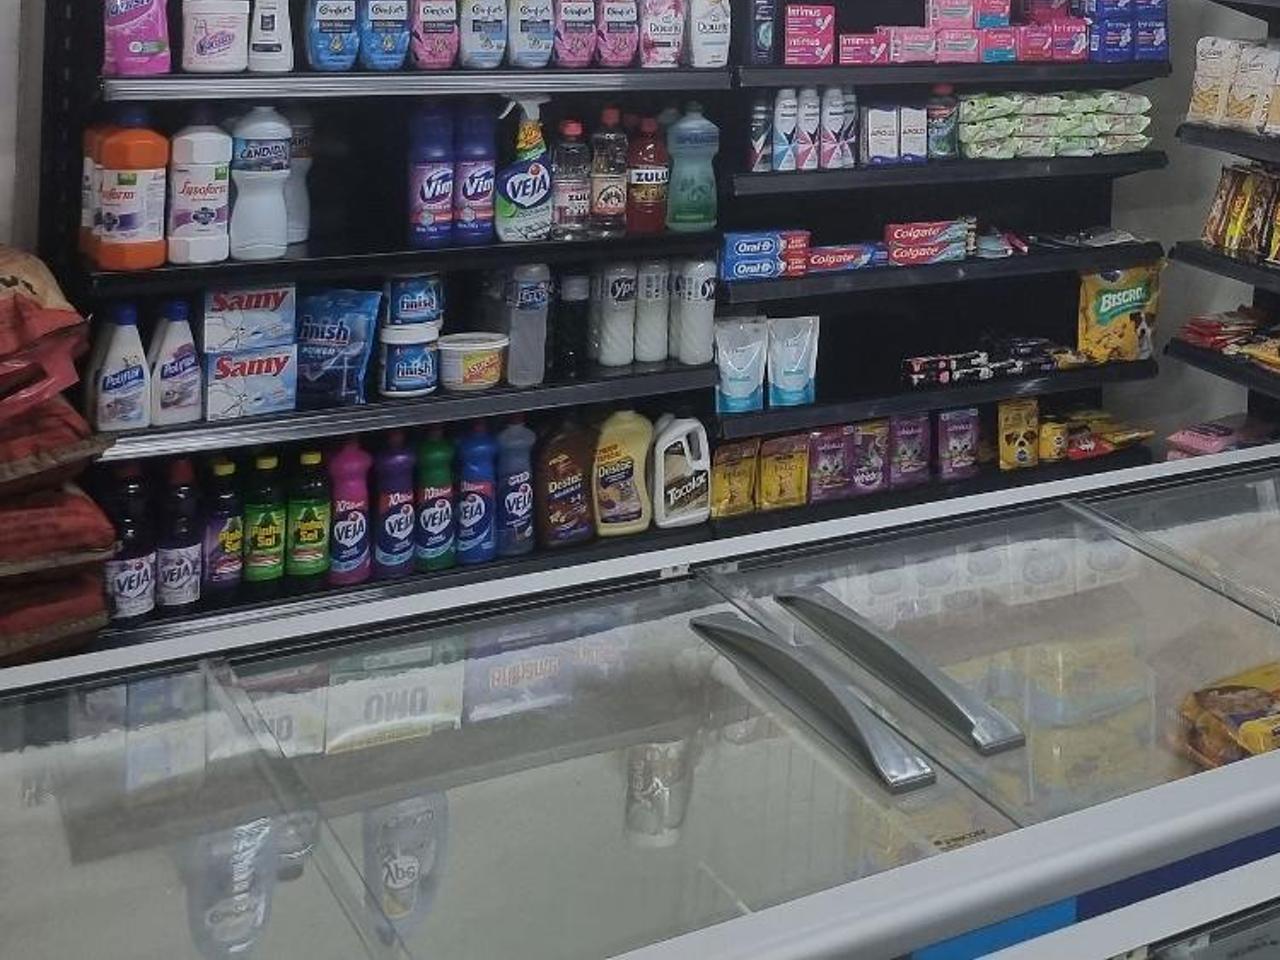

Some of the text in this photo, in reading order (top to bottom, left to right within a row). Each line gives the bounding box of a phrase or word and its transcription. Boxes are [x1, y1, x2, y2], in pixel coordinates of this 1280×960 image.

[787, 6, 821, 18] Intimus
[510, 175, 549, 201] VEJA
[893, 226, 941, 240] Colgate
[810, 252, 855, 266] Colgate
[891, 246, 939, 260] Colgate
[210, 289, 289, 313] Samy
[1100, 286, 1146, 312] BISCRO
[214, 354, 290, 380] Samy
[335, 521, 366, 541] VEJA
[257, 535, 276, 548] Sol
[116, 569, 150, 591] VEJA
